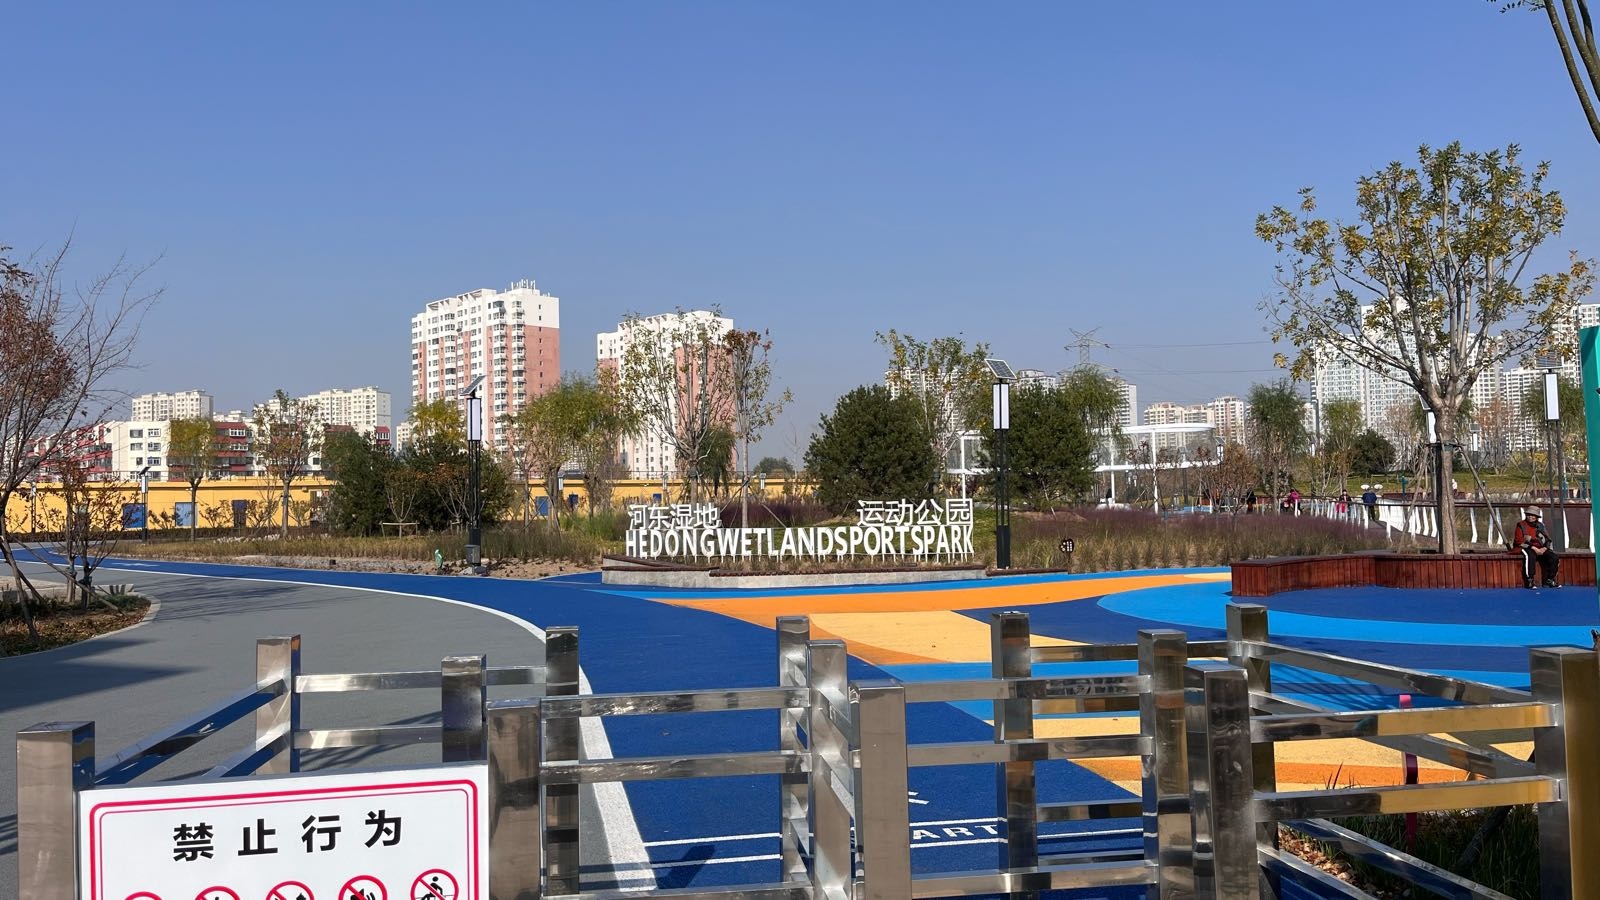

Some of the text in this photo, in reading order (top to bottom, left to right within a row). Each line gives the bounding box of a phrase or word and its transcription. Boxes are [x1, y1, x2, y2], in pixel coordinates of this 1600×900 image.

[627, 498, 973, 530] 河东湿地 运动公园
[172, 810, 401, 862] 禁止行为
[912, 824, 998, 840] ART
